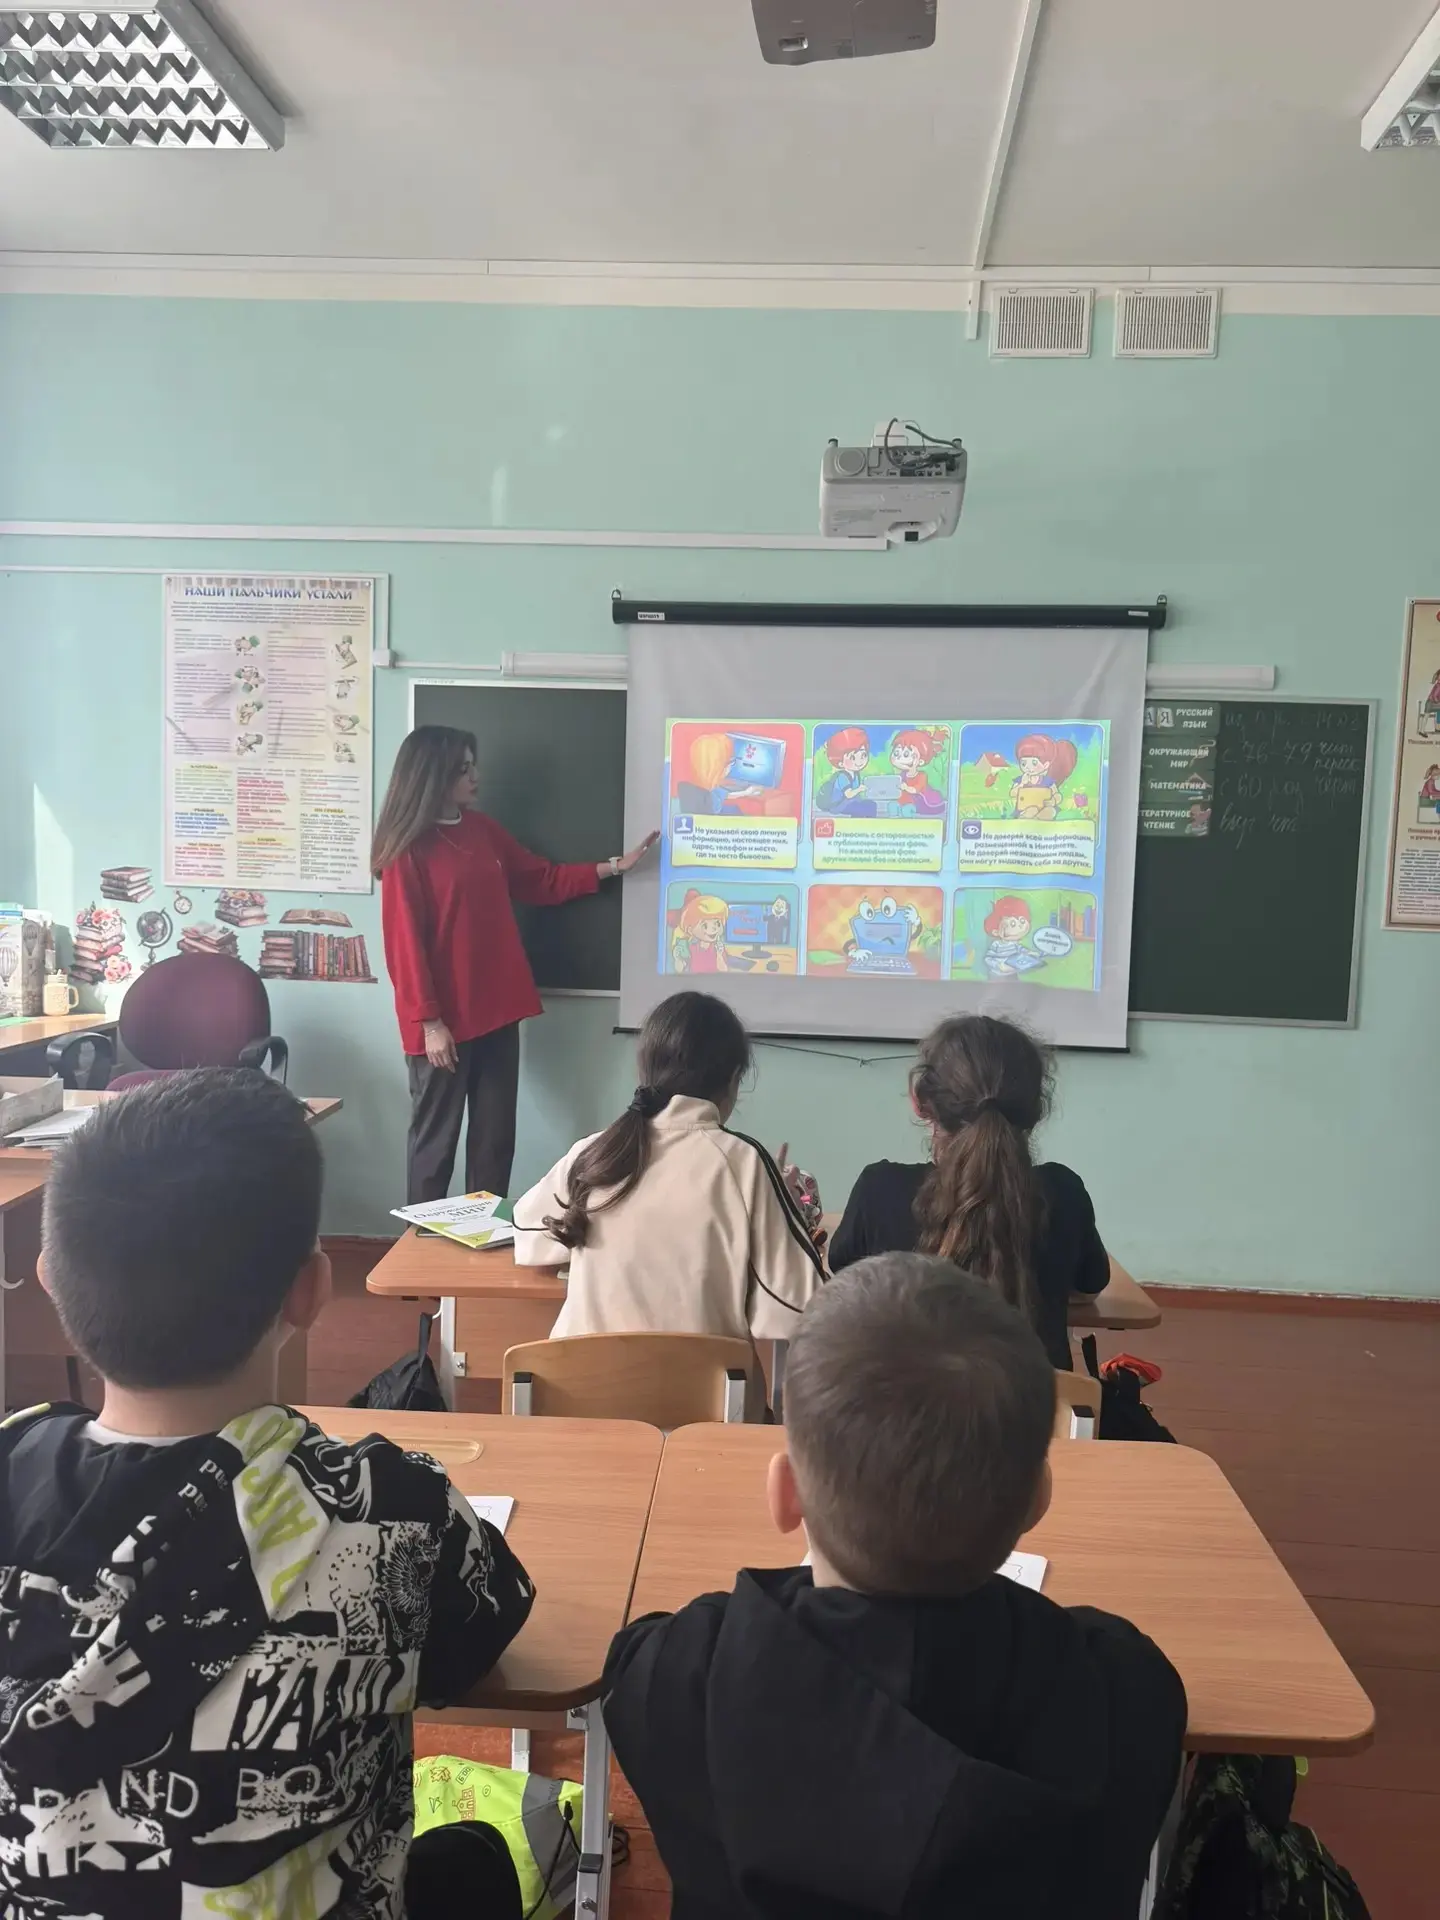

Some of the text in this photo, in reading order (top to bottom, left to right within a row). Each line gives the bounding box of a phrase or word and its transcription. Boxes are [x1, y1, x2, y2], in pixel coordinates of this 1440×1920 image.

[184, 586, 352, 600] НАШИ ПАЛЬЧИКИ УСТАЛИ
[1176, 706, 1214, 716] РУССКИЙ
[1182, 720, 1208, 728] ЯЗЫК
[1148, 746, 1210, 757] ОКРУЖАЮЩИЙ
[1170, 760, 1188, 768] МИР
[1150, 782, 1207, 790] МАТЕМАТИКА
[1140, 810, 1191, 818] ТЕРАТУРНОЕ
